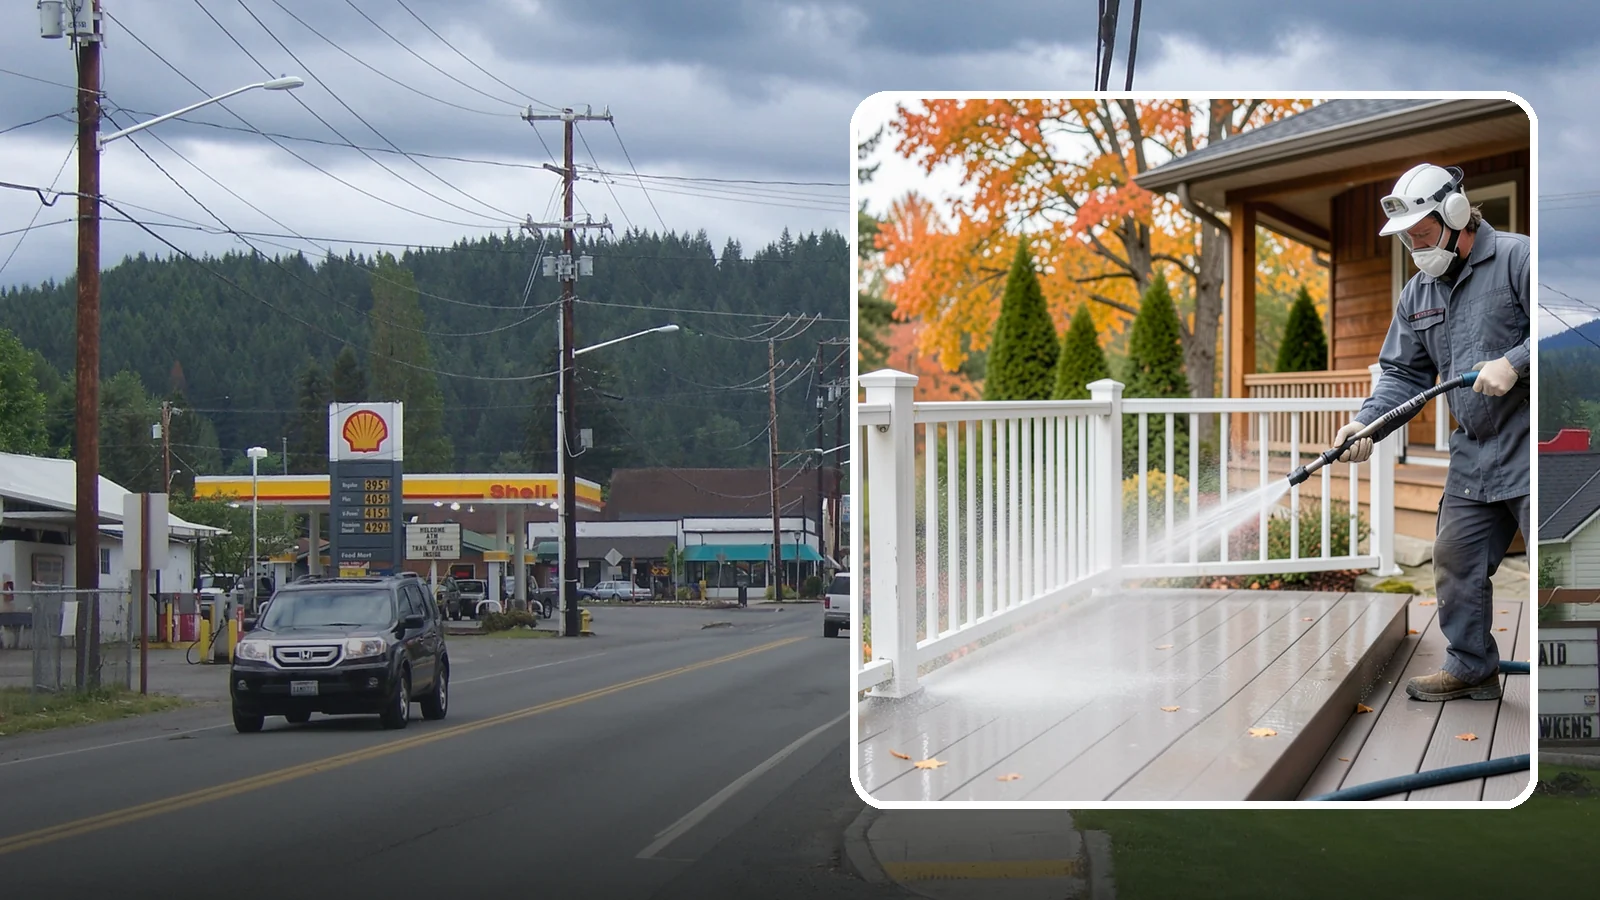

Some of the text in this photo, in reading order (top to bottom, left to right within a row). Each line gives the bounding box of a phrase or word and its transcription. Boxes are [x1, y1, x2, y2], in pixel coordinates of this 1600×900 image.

[366, 480, 383, 490] 395
[490, 484, 547, 499] Shell
[366, 494, 383, 504] 405
[366, 508, 383, 518] 415
[366, 522, 383, 533] 429
